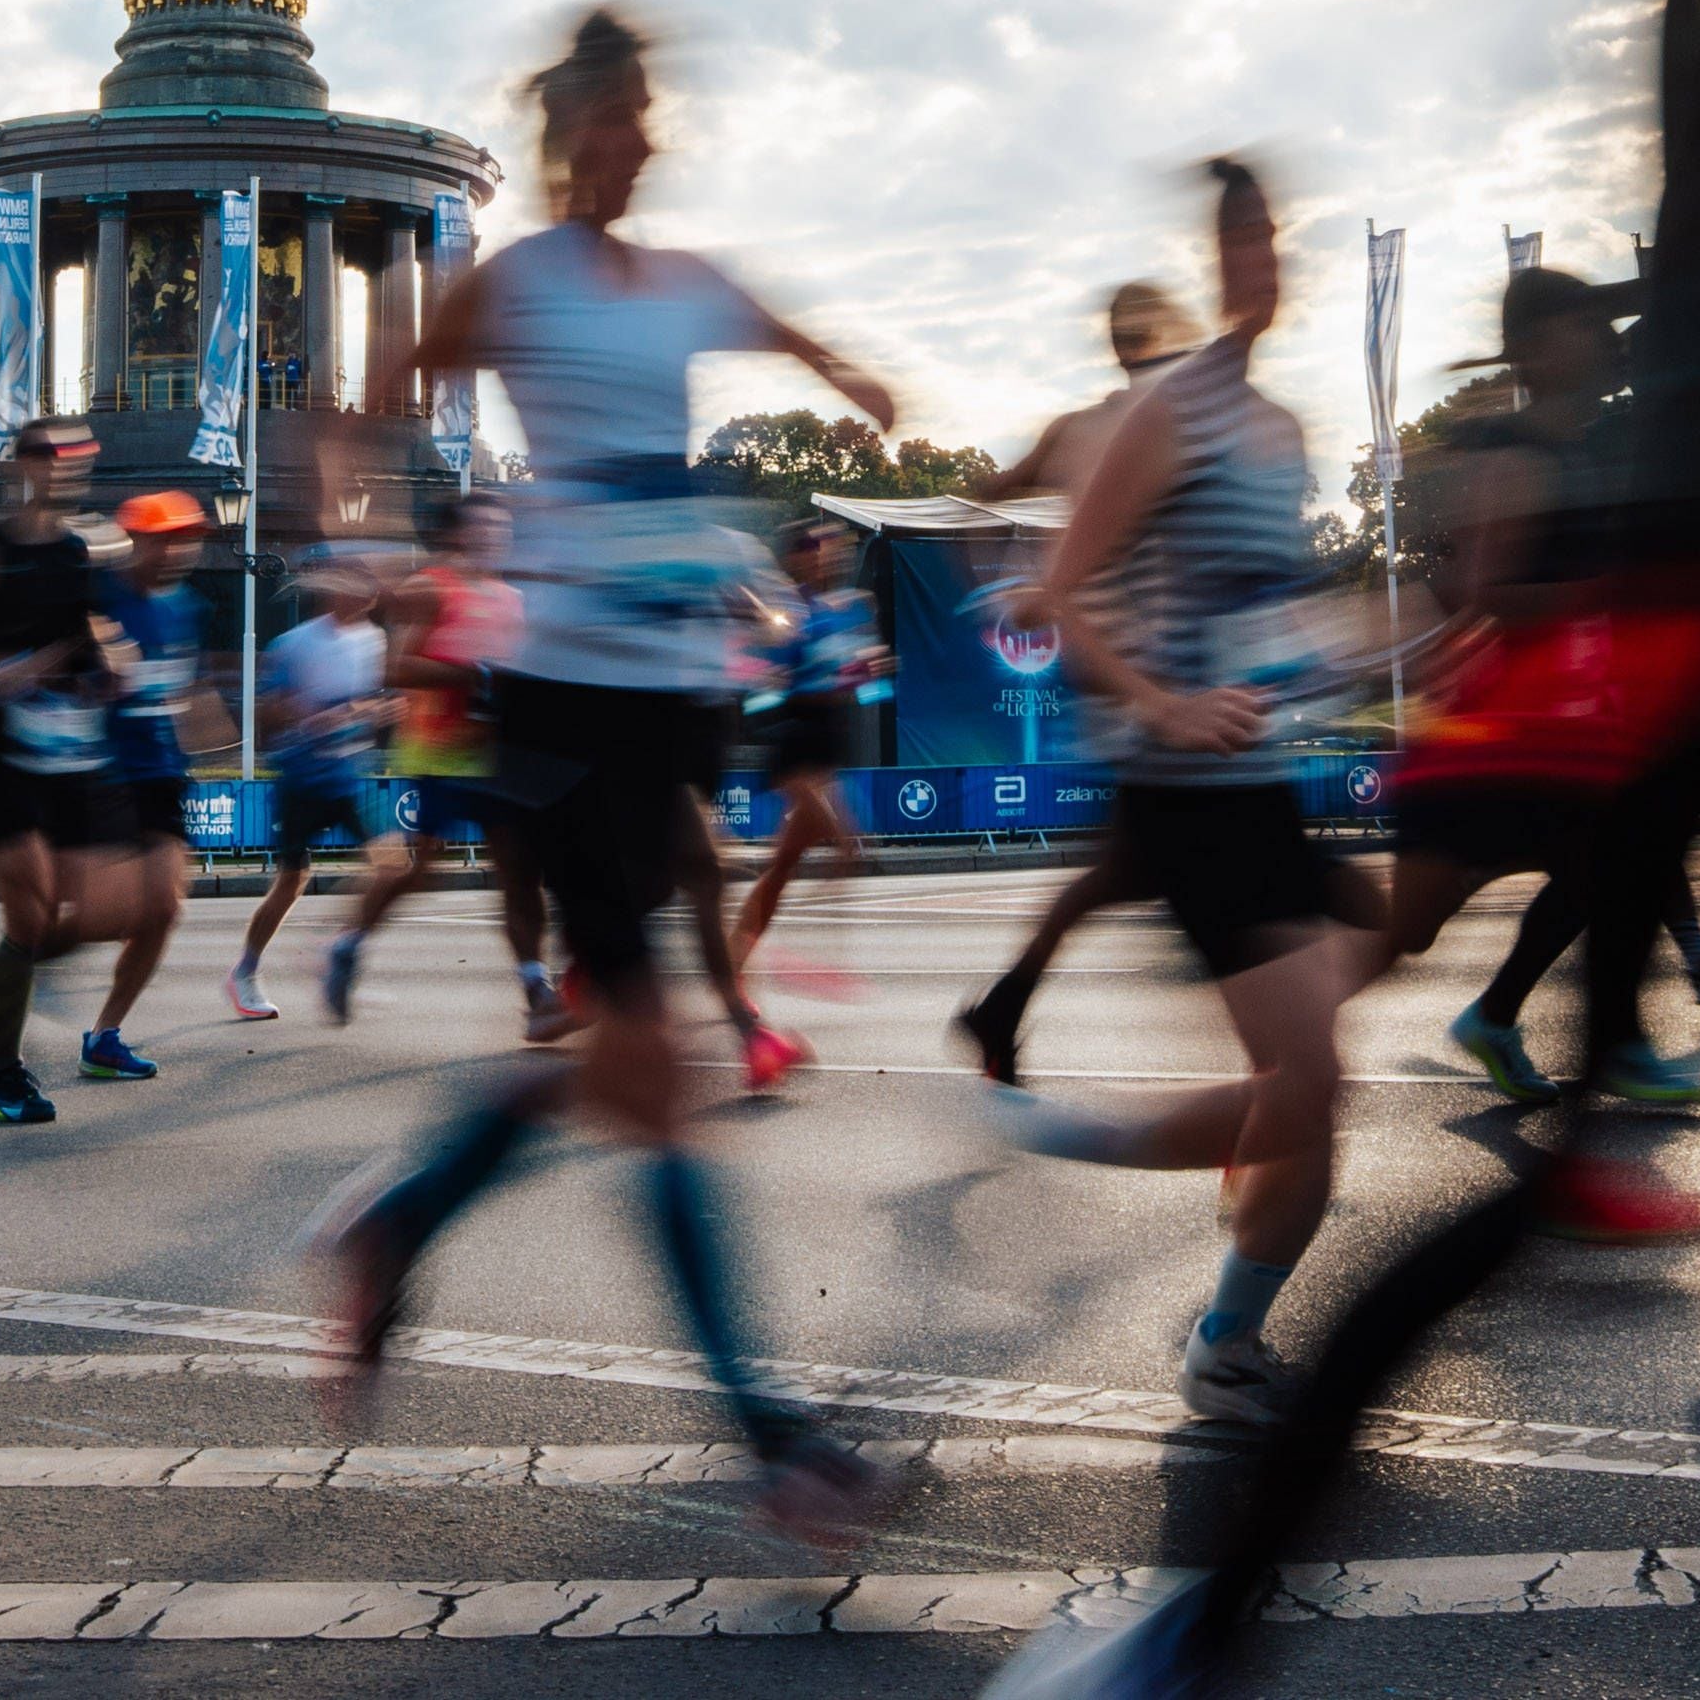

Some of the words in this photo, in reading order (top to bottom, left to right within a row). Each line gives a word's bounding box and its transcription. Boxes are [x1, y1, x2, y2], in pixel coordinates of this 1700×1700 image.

[1001, 689, 1060, 702] FESTIVAL
[1007, 701, 1060, 717] LIGHTS
[1055, 786, 1124, 802] zaland
[179, 799, 209, 814] MW
[181, 814, 210, 824] RLIN
[184, 825, 234, 836] RATHON
